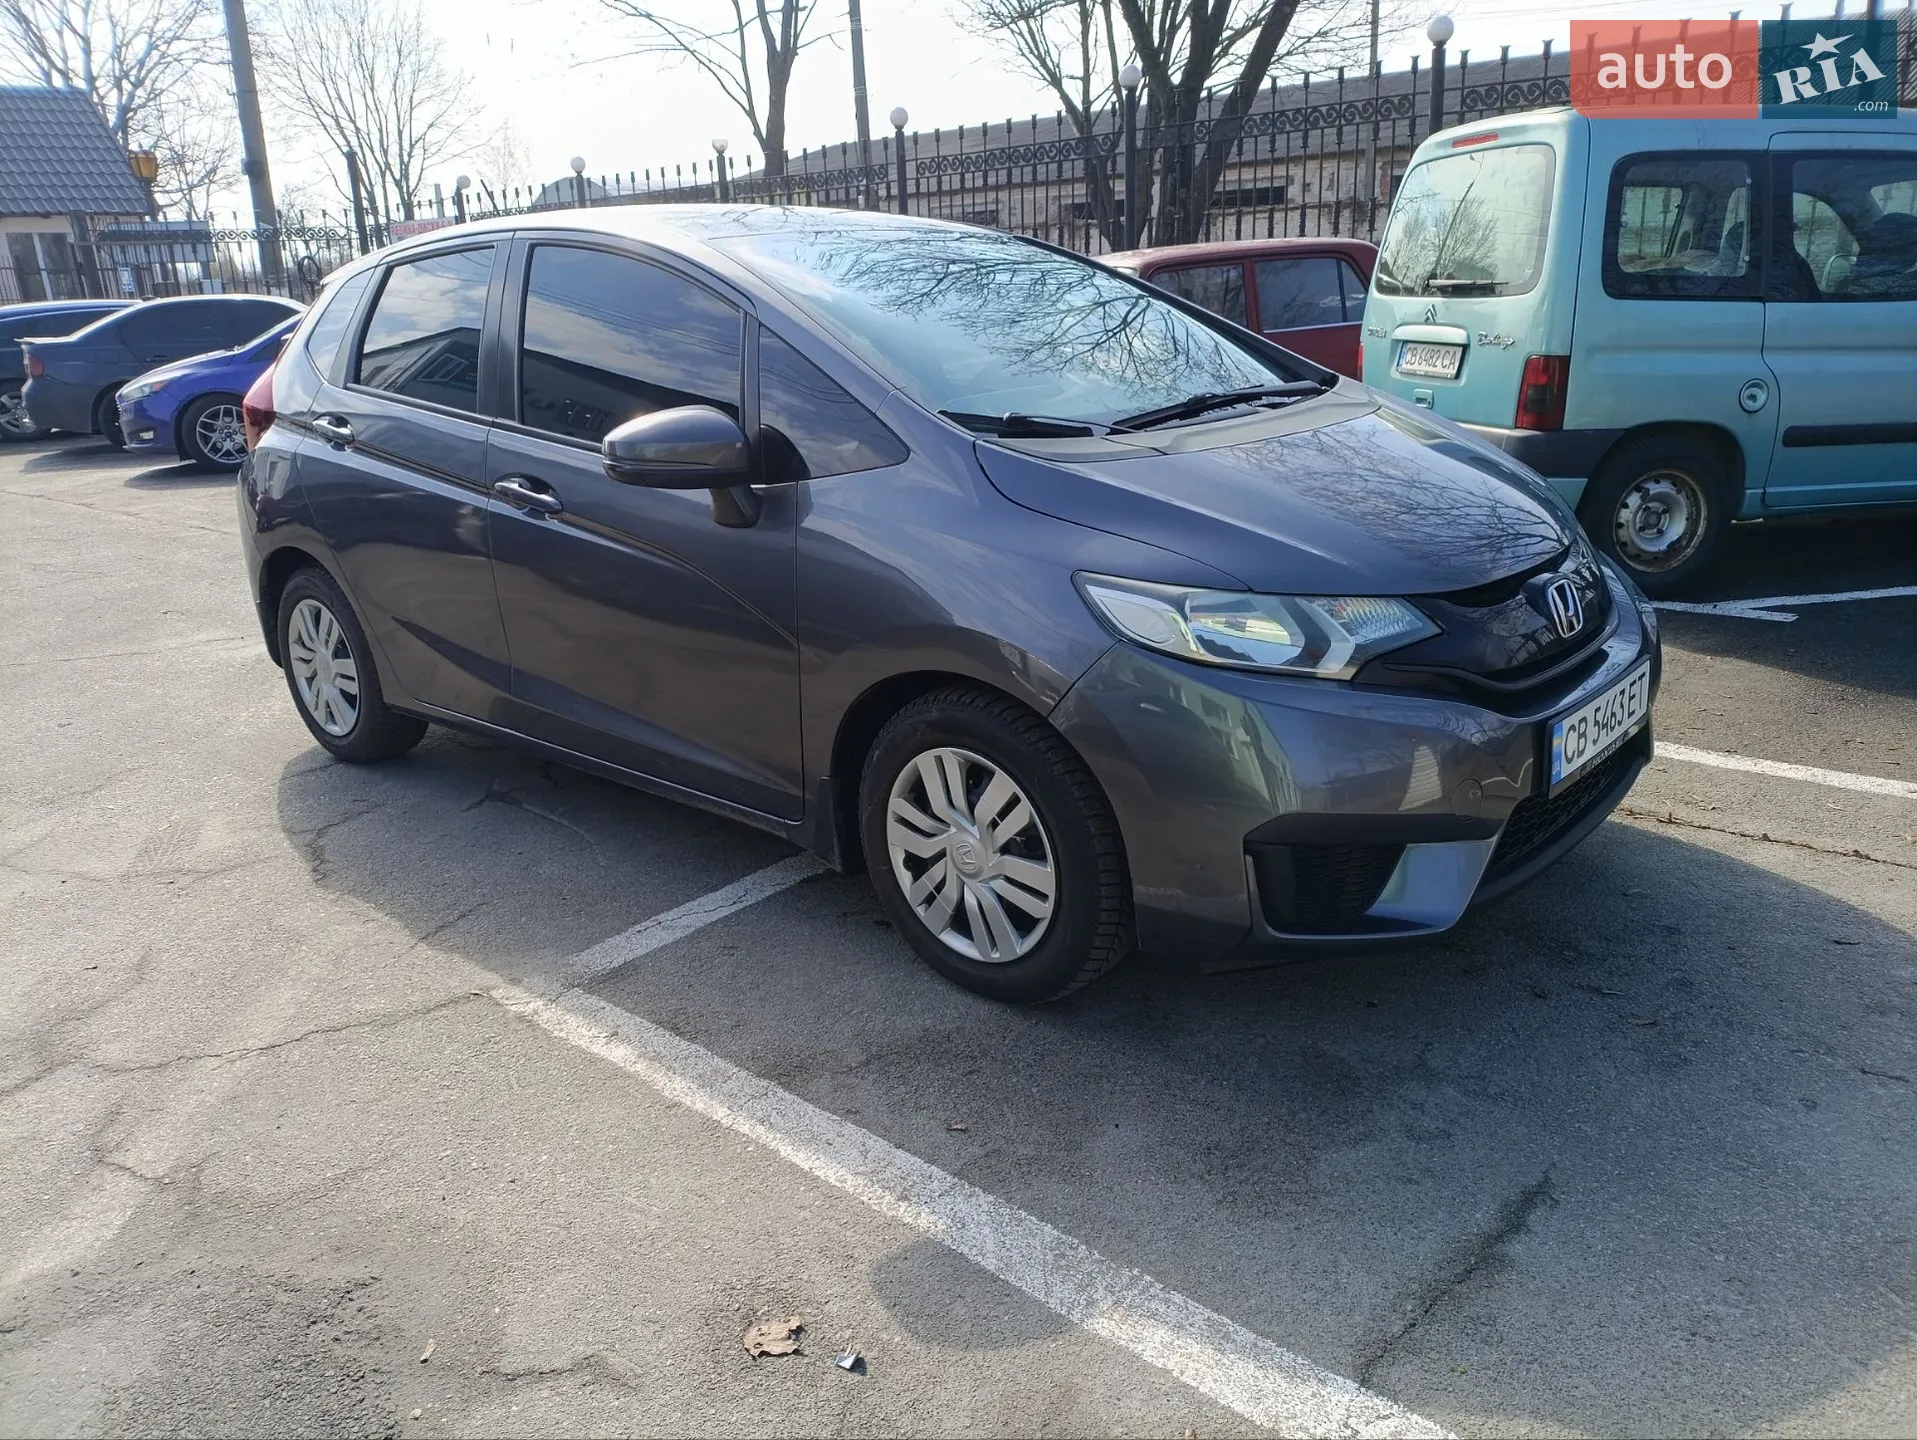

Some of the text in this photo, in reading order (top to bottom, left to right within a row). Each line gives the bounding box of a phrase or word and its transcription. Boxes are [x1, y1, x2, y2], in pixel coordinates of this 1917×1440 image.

[1405, 347, 1417, 367] CB
[1417, 349, 1441, 369] 6482
[1441, 351, 1457, 370] CA
[1564, 671, 1646, 765] CB 5463 ET
